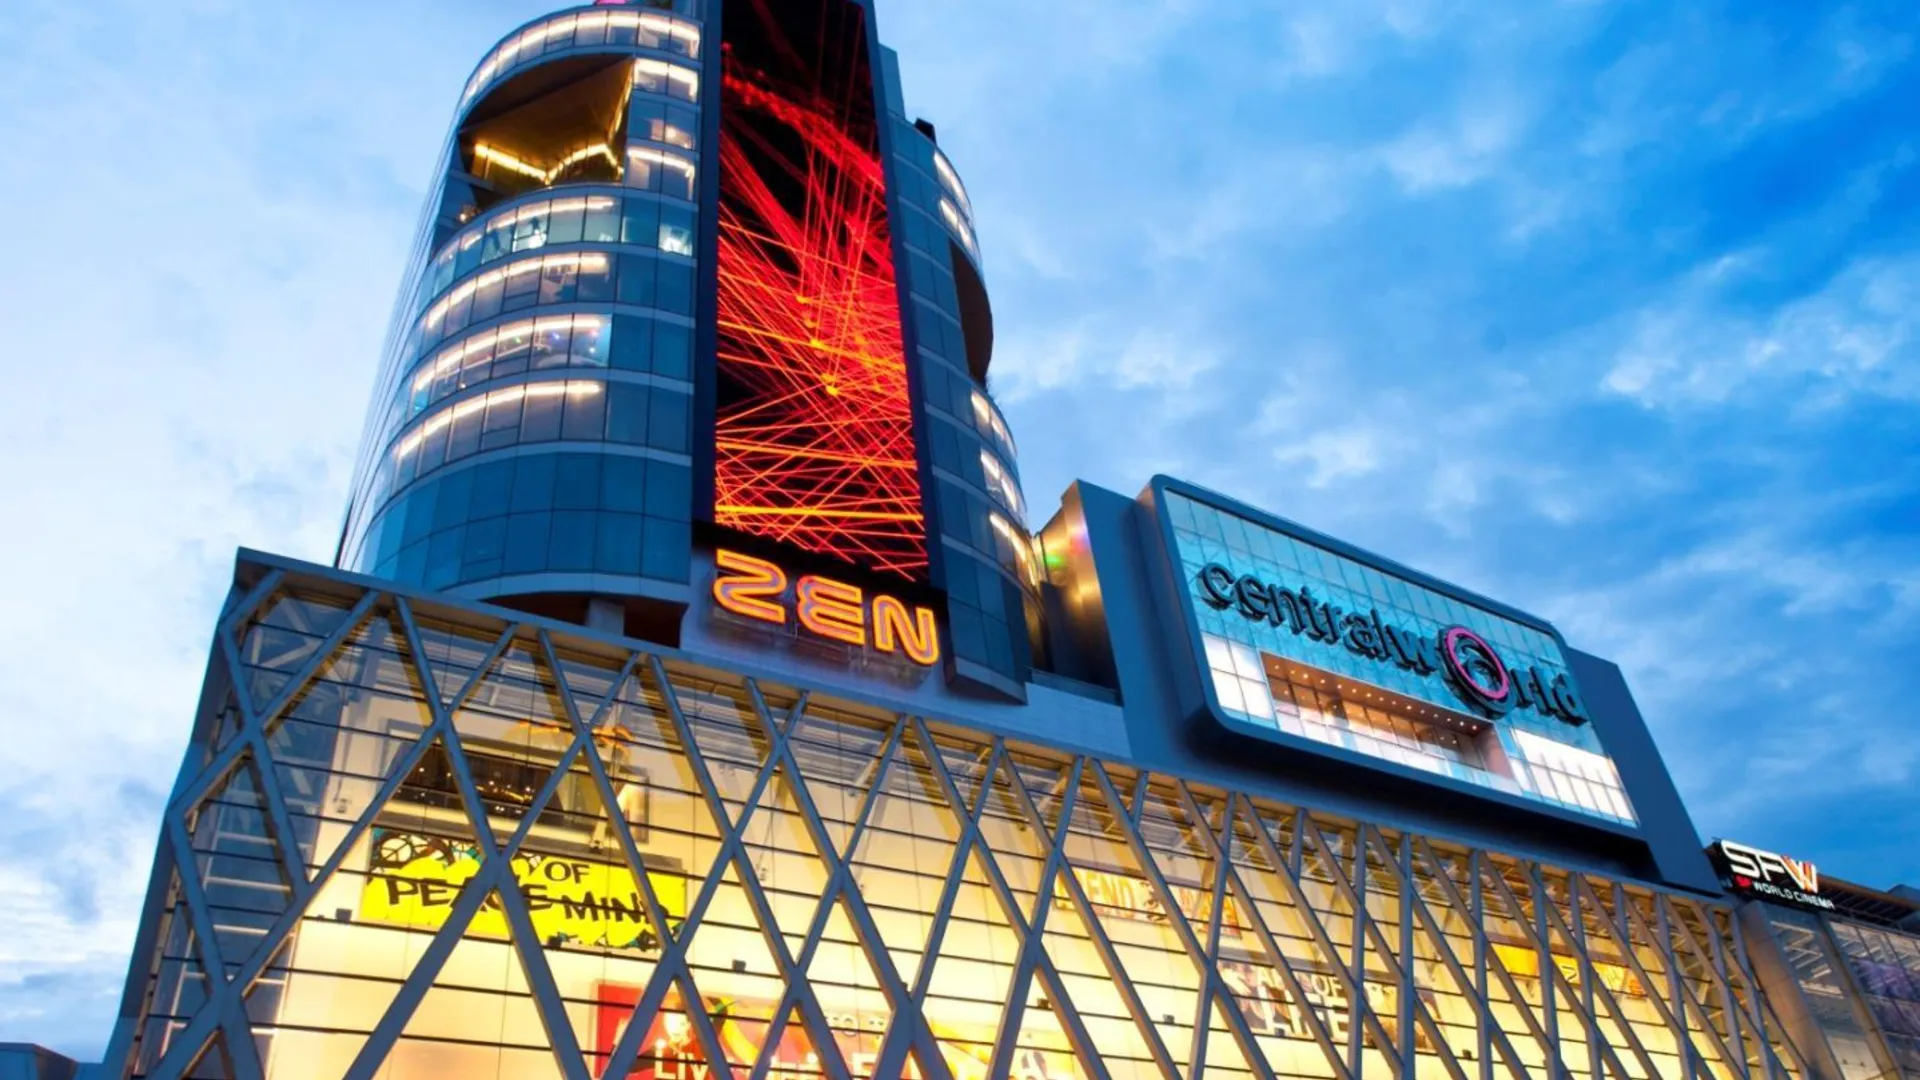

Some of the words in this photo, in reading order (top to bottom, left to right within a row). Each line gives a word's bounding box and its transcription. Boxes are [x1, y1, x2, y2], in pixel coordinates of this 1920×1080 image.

[713, 548, 940, 665] ZEN
[544, 861, 590, 884] OF
[386, 875, 552, 912] PEE
[1752, 881, 1794, 900] WORLD
[1793, 890, 1836, 910] CINEMA
